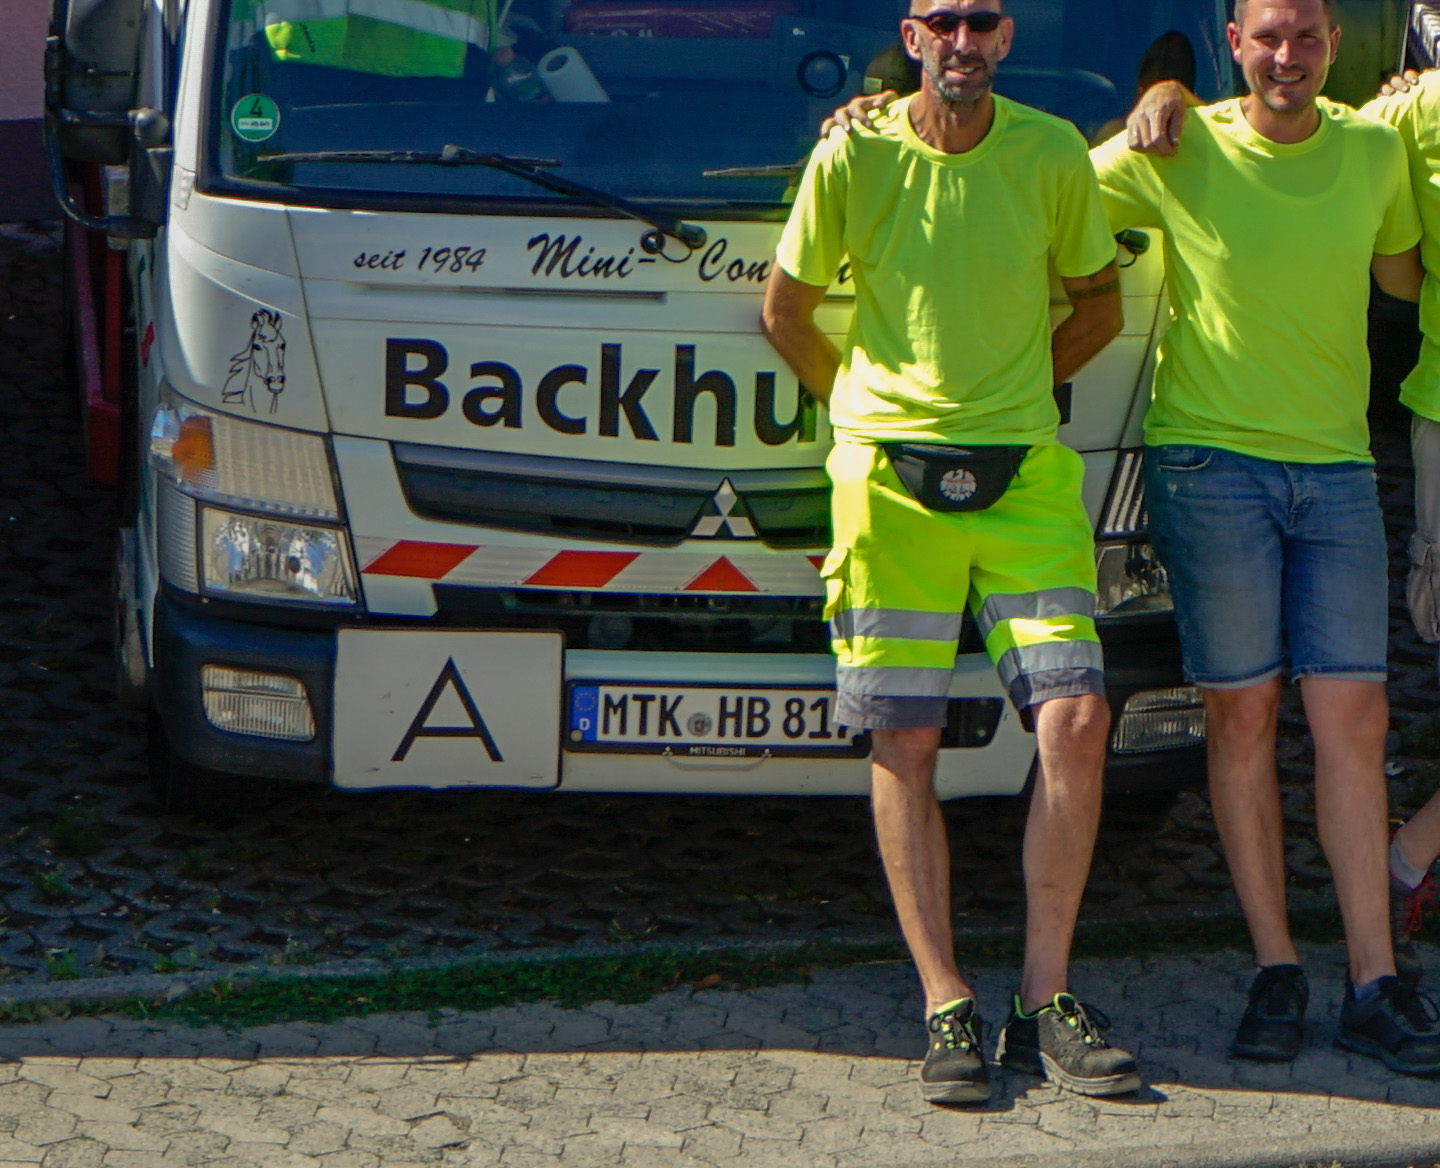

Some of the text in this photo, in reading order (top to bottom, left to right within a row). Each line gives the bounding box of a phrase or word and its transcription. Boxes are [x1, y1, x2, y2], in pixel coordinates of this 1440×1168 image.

[250, 97, 263, 118] 4
[354, 248, 406, 271] seit
[417, 246, 488, 273] 1984
[526, 232, 656, 279] Mini-
[384, 337, 817, 448] Backhu
[391, 655, 505, 763] A
[579, 718, 590, 731] D
[603, 693, 855, 740] MTK HB 81
